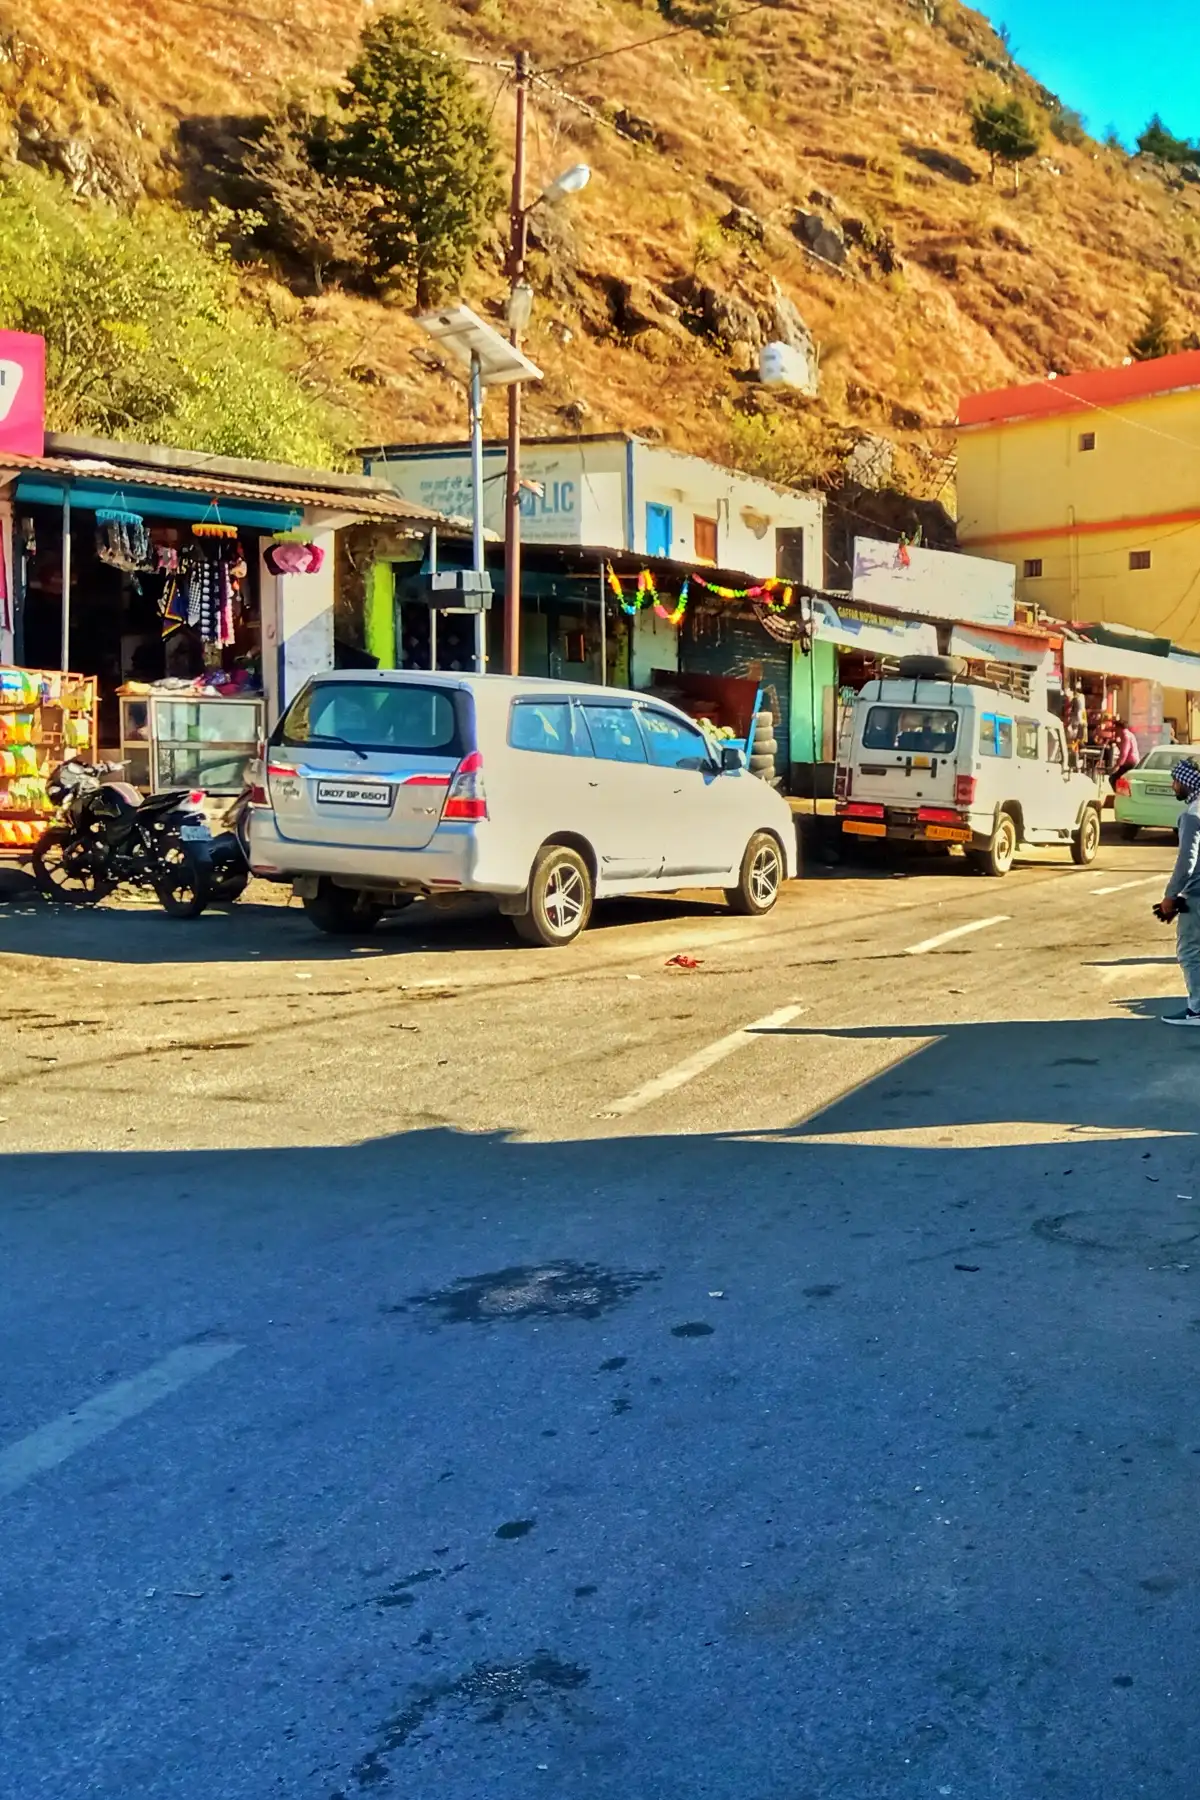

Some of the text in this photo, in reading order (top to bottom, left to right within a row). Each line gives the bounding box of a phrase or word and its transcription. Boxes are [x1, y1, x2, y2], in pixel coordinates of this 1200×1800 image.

[541, 481, 574, 513] LIC
[319, 788, 387, 802] UK07 BP 6501
